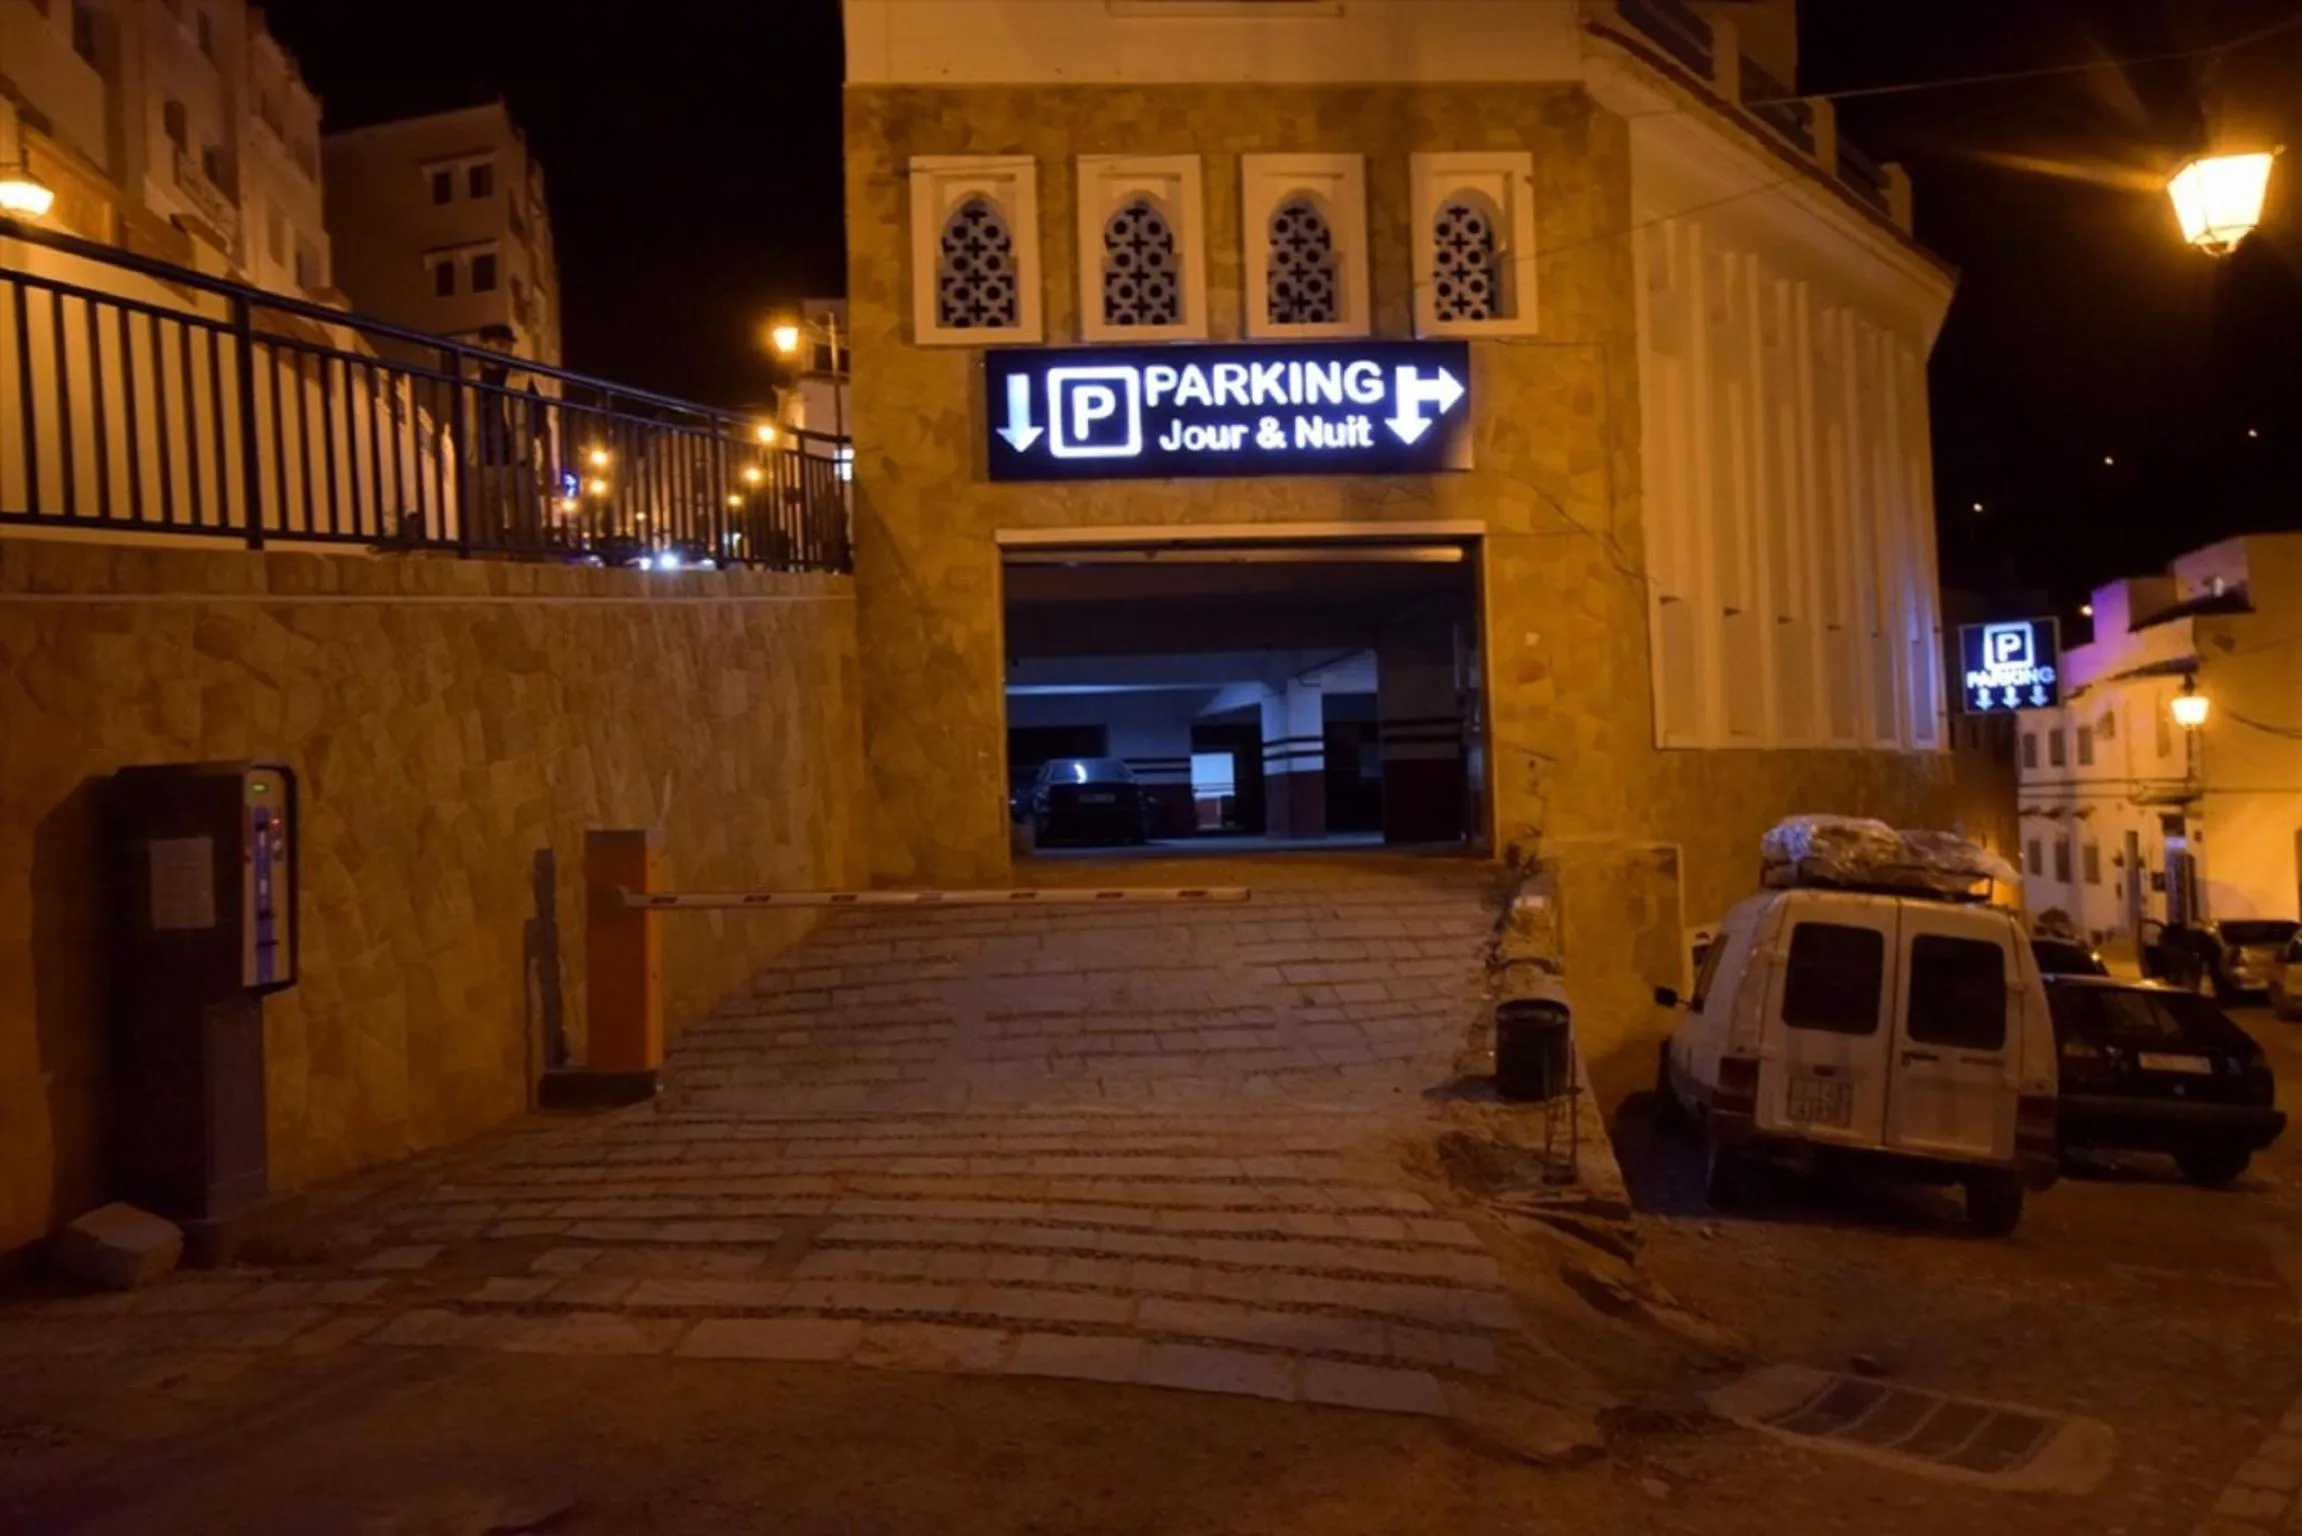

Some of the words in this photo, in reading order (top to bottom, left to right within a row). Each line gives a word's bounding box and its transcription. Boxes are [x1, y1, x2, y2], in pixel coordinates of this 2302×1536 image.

[1144, 360, 1386, 408] PARKING
[1072, 386, 1117, 441] P
[1159, 419, 1249, 452] Jour
[1255, 416, 1288, 450] &
[1294, 414, 1375, 449] Nuit
[1996, 632, 2022, 662] P
